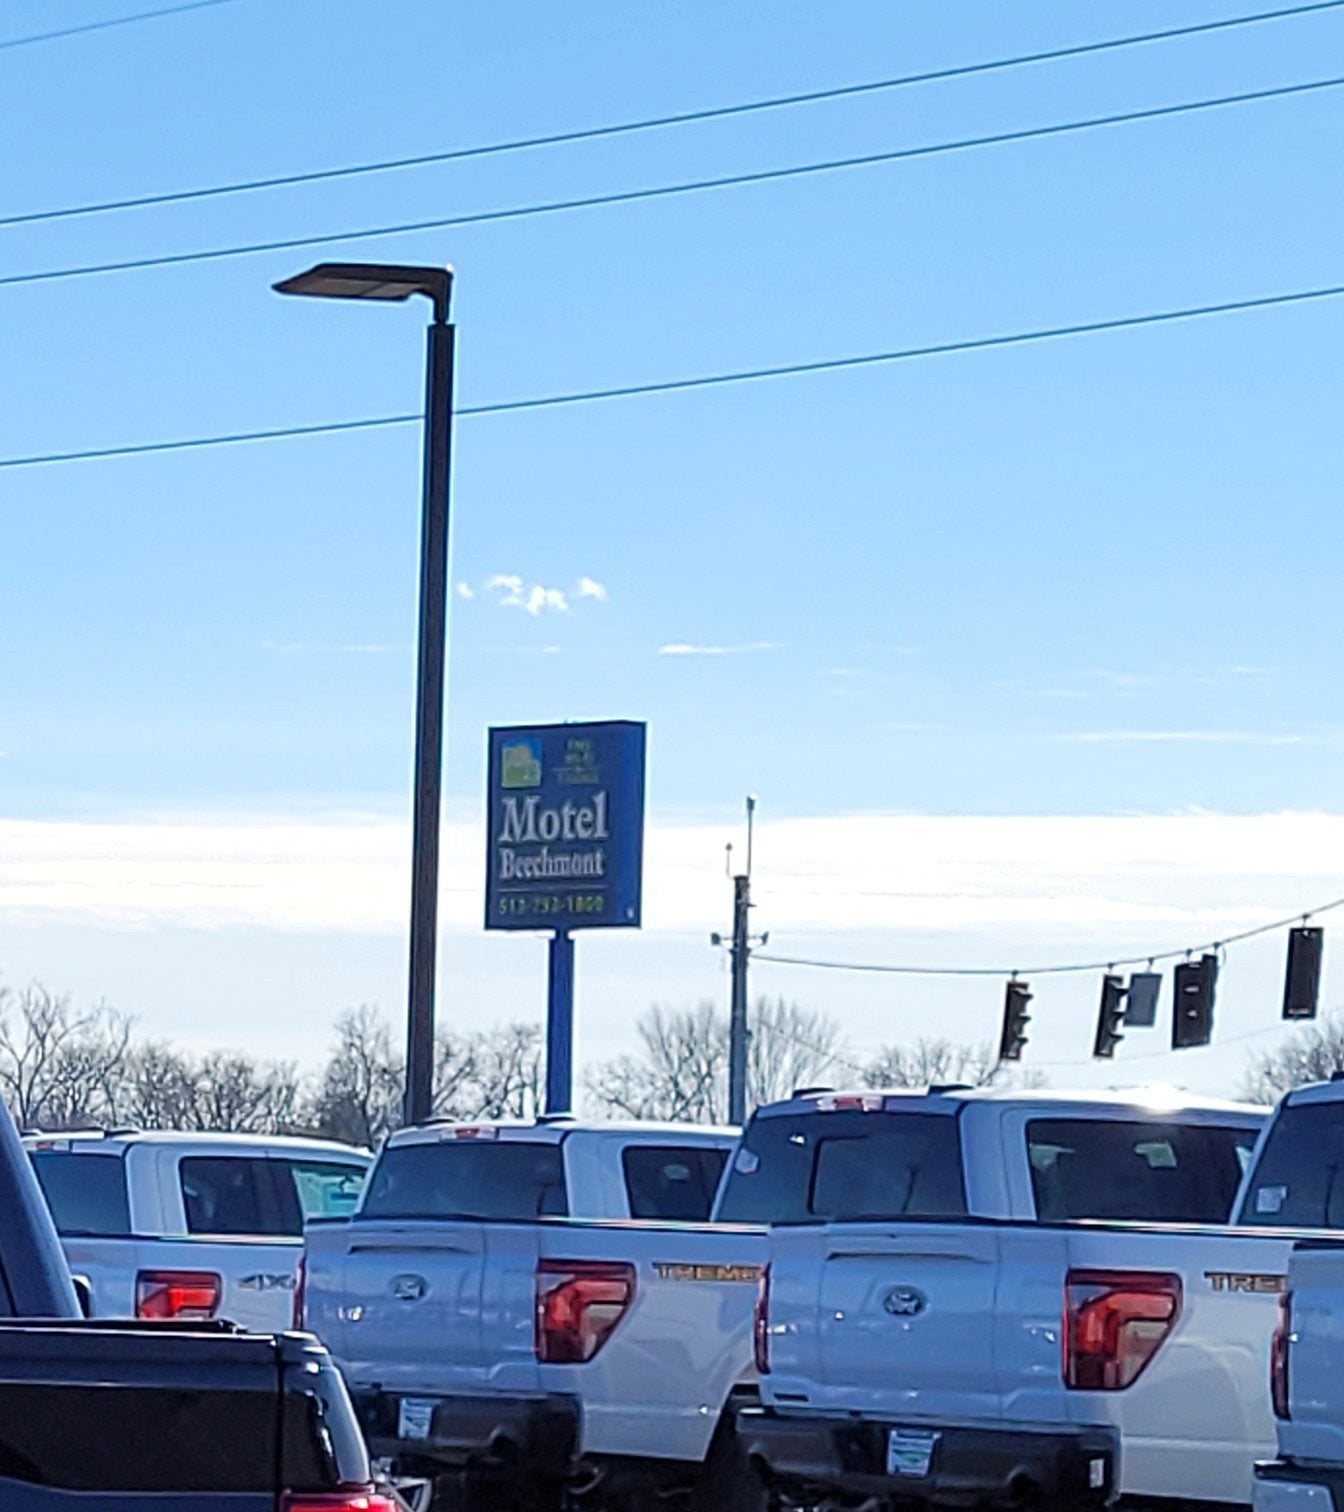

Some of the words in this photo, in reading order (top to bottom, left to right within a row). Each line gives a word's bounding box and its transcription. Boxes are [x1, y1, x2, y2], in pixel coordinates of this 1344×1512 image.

[498, 791, 609, 842] Motel
[499, 846, 604, 879] Beechmont
[238, 1274, 296, 1291] 4X
[652, 1262, 766, 1282] TREMO
